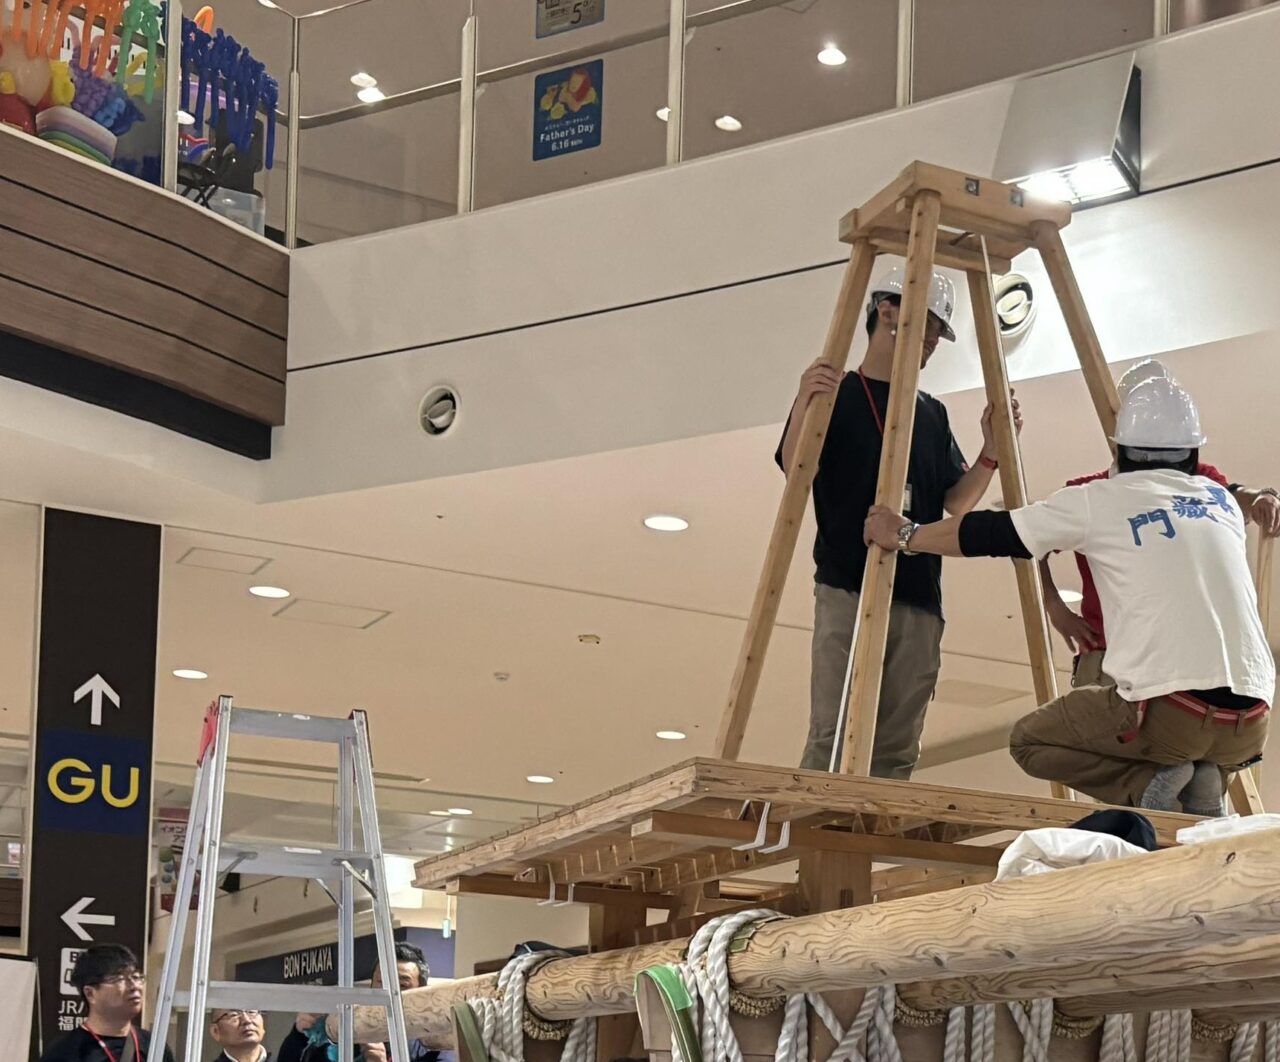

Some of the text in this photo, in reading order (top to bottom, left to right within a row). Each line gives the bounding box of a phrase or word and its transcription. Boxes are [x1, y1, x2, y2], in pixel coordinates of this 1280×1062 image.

[540, 126, 576, 143] Father's
[577, 123, 595, 134] Day
[47, 758, 140, 808] GU
[283, 946, 333, 979] BON FUKAYA
